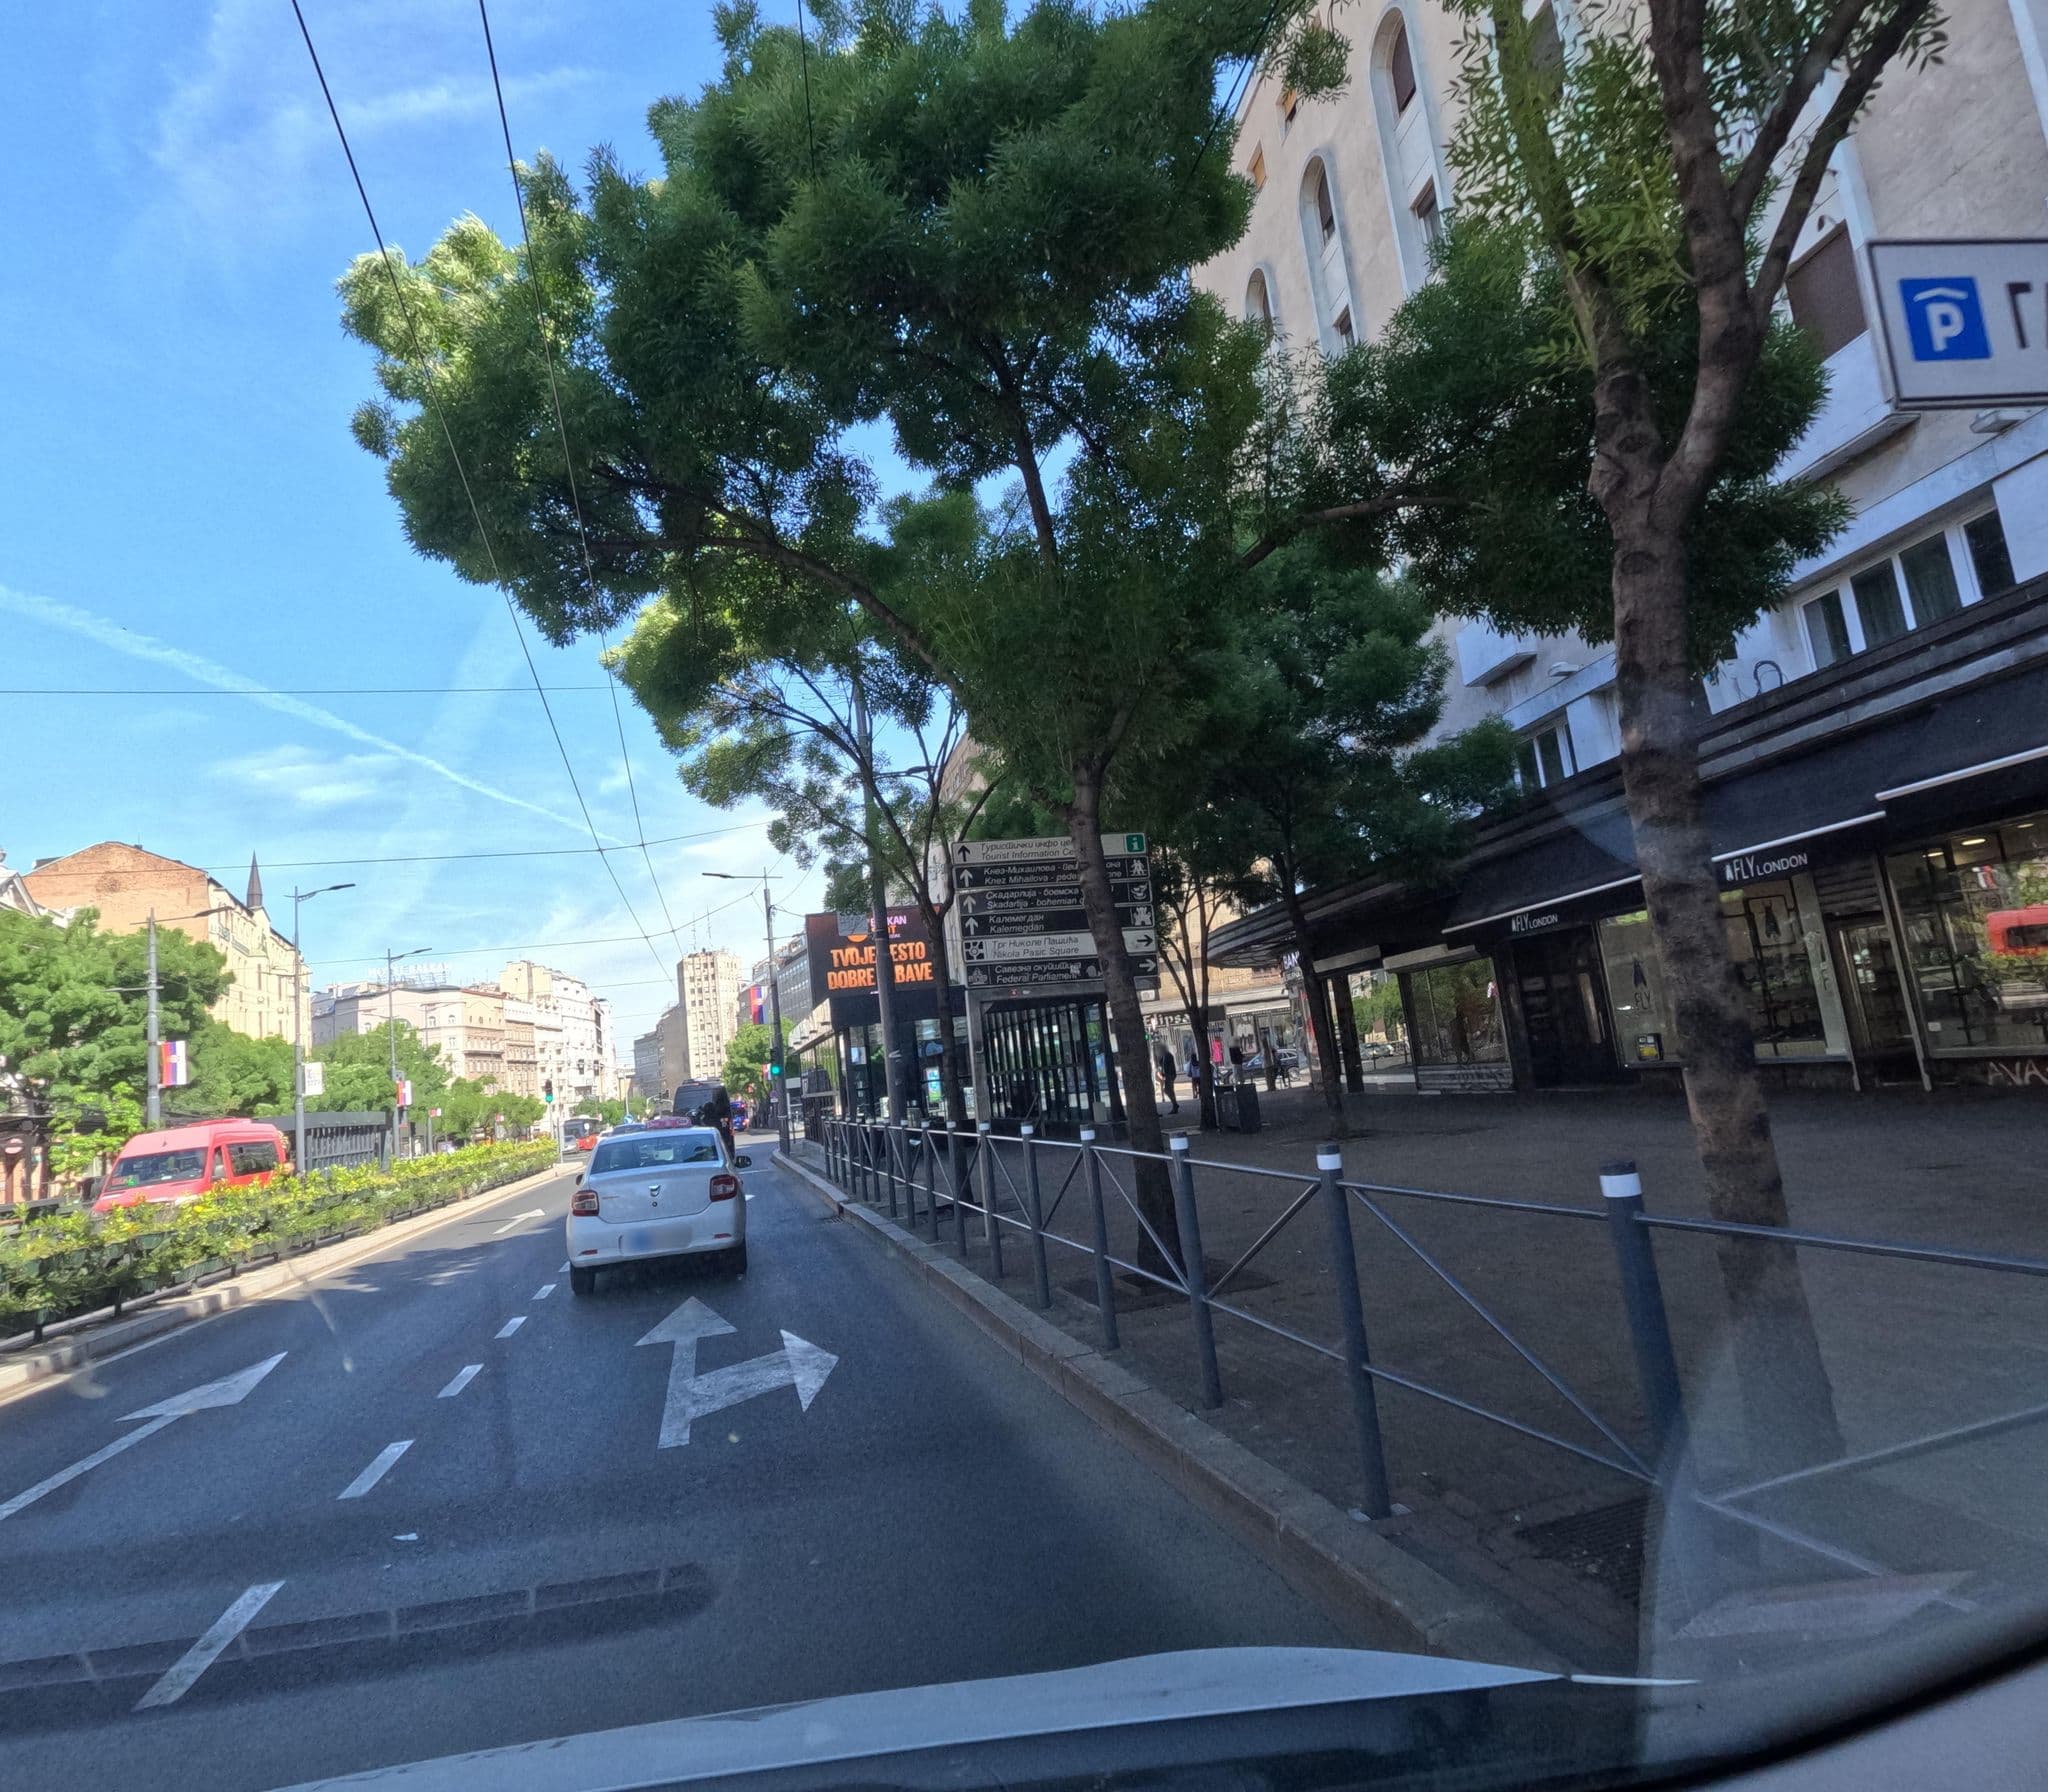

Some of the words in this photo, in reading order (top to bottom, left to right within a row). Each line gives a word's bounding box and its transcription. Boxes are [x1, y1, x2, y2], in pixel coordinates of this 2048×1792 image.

[982, 852, 1010, 861] Tourist
[1733, 855, 1755, 881] FLY
[1757, 852, 1808, 876] LONDON
[984, 876, 1006, 885] Knez
[1008, 874, 1049, 884] Mihailova
[1036, 898, 1077, 906] bohemian
[989, 914, 1044, 924] Калемегдан
[1516, 912, 1529, 931] FLY
[1529, 913, 1558, 929] LONDON
[989, 923, 1045, 934] Kalemegdan
[992, 940, 1006, 950] Трг
[1008, 938, 1042, 948] Николе
[1044, 936, 1079, 946] Пашића
[830, 946, 876, 968] TVOJE
[890, 941, 926, 961] ESTO
[992, 950, 1021, 959] Nikola
[1049, 946, 1080, 957] Square
[826, 968, 876, 990] DOBRE
[996, 974, 1030, 984] Federal
